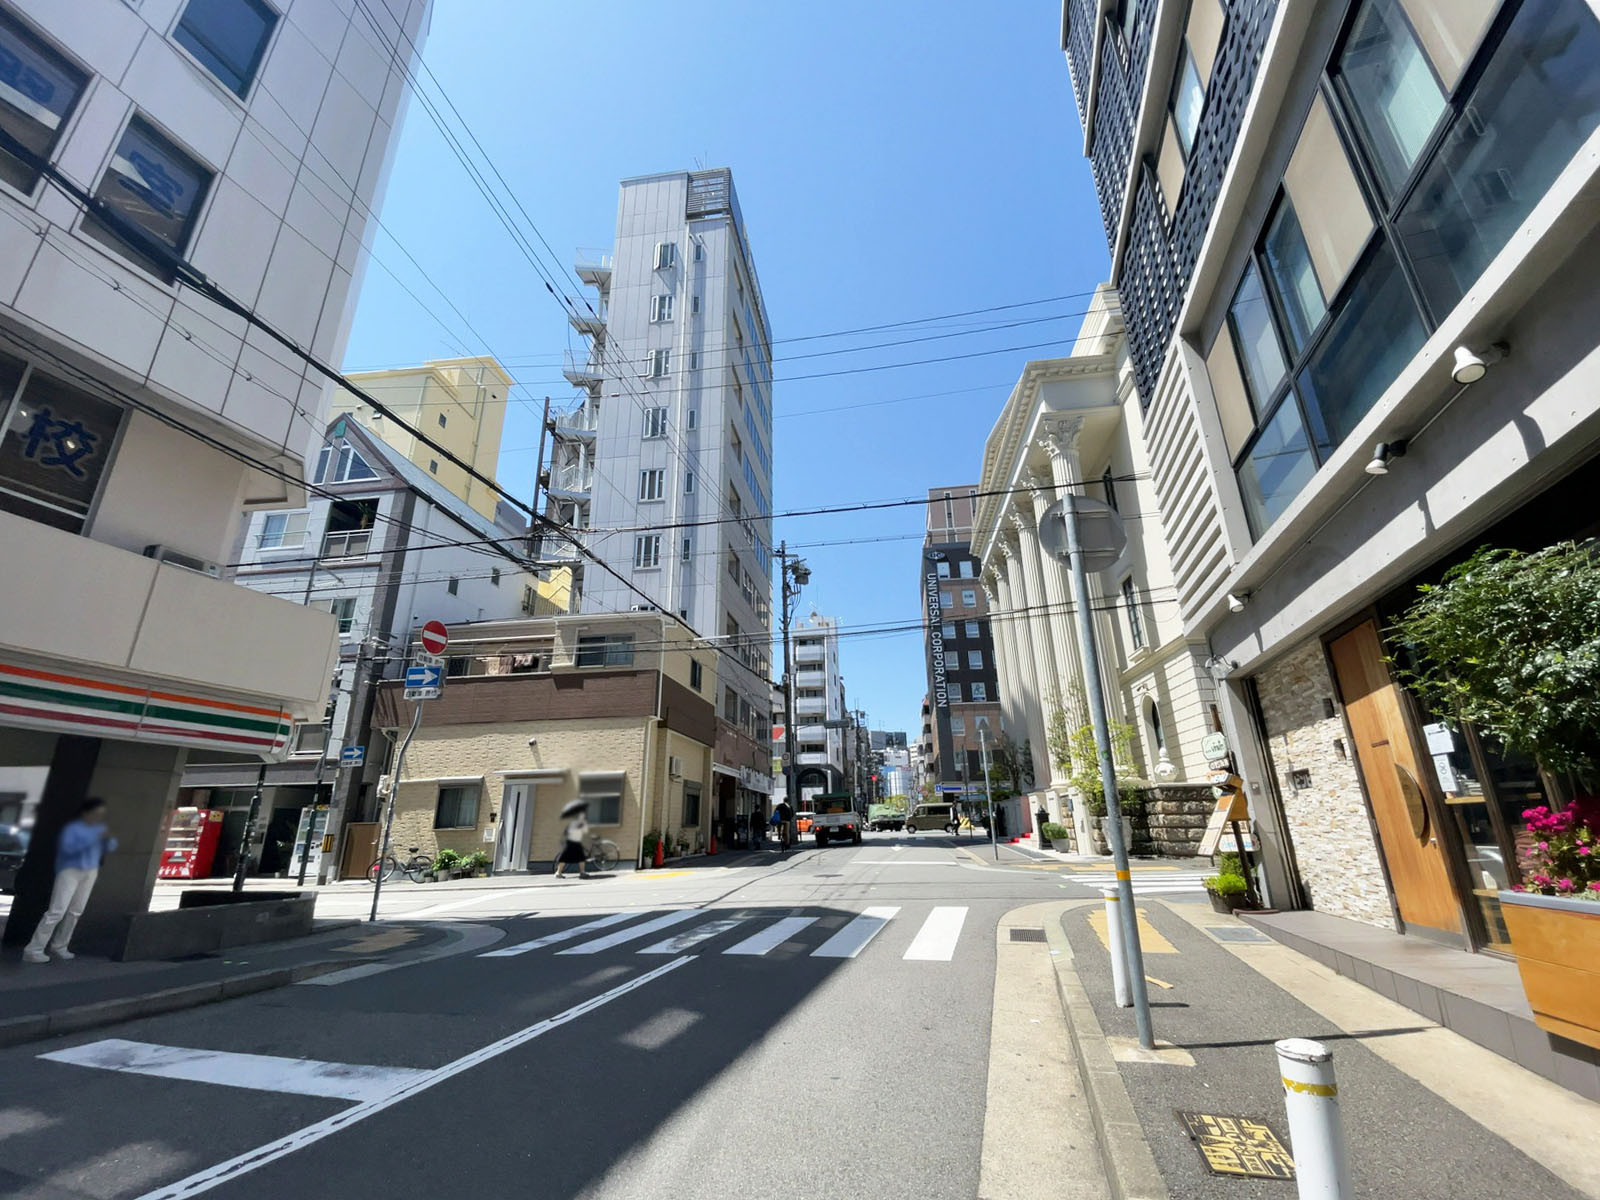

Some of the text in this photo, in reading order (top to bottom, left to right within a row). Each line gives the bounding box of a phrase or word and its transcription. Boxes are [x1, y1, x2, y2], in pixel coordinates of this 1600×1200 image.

[22, 407, 98, 478] 校
[926, 572, 947, 708] UNIVERSAL CORPORATION
